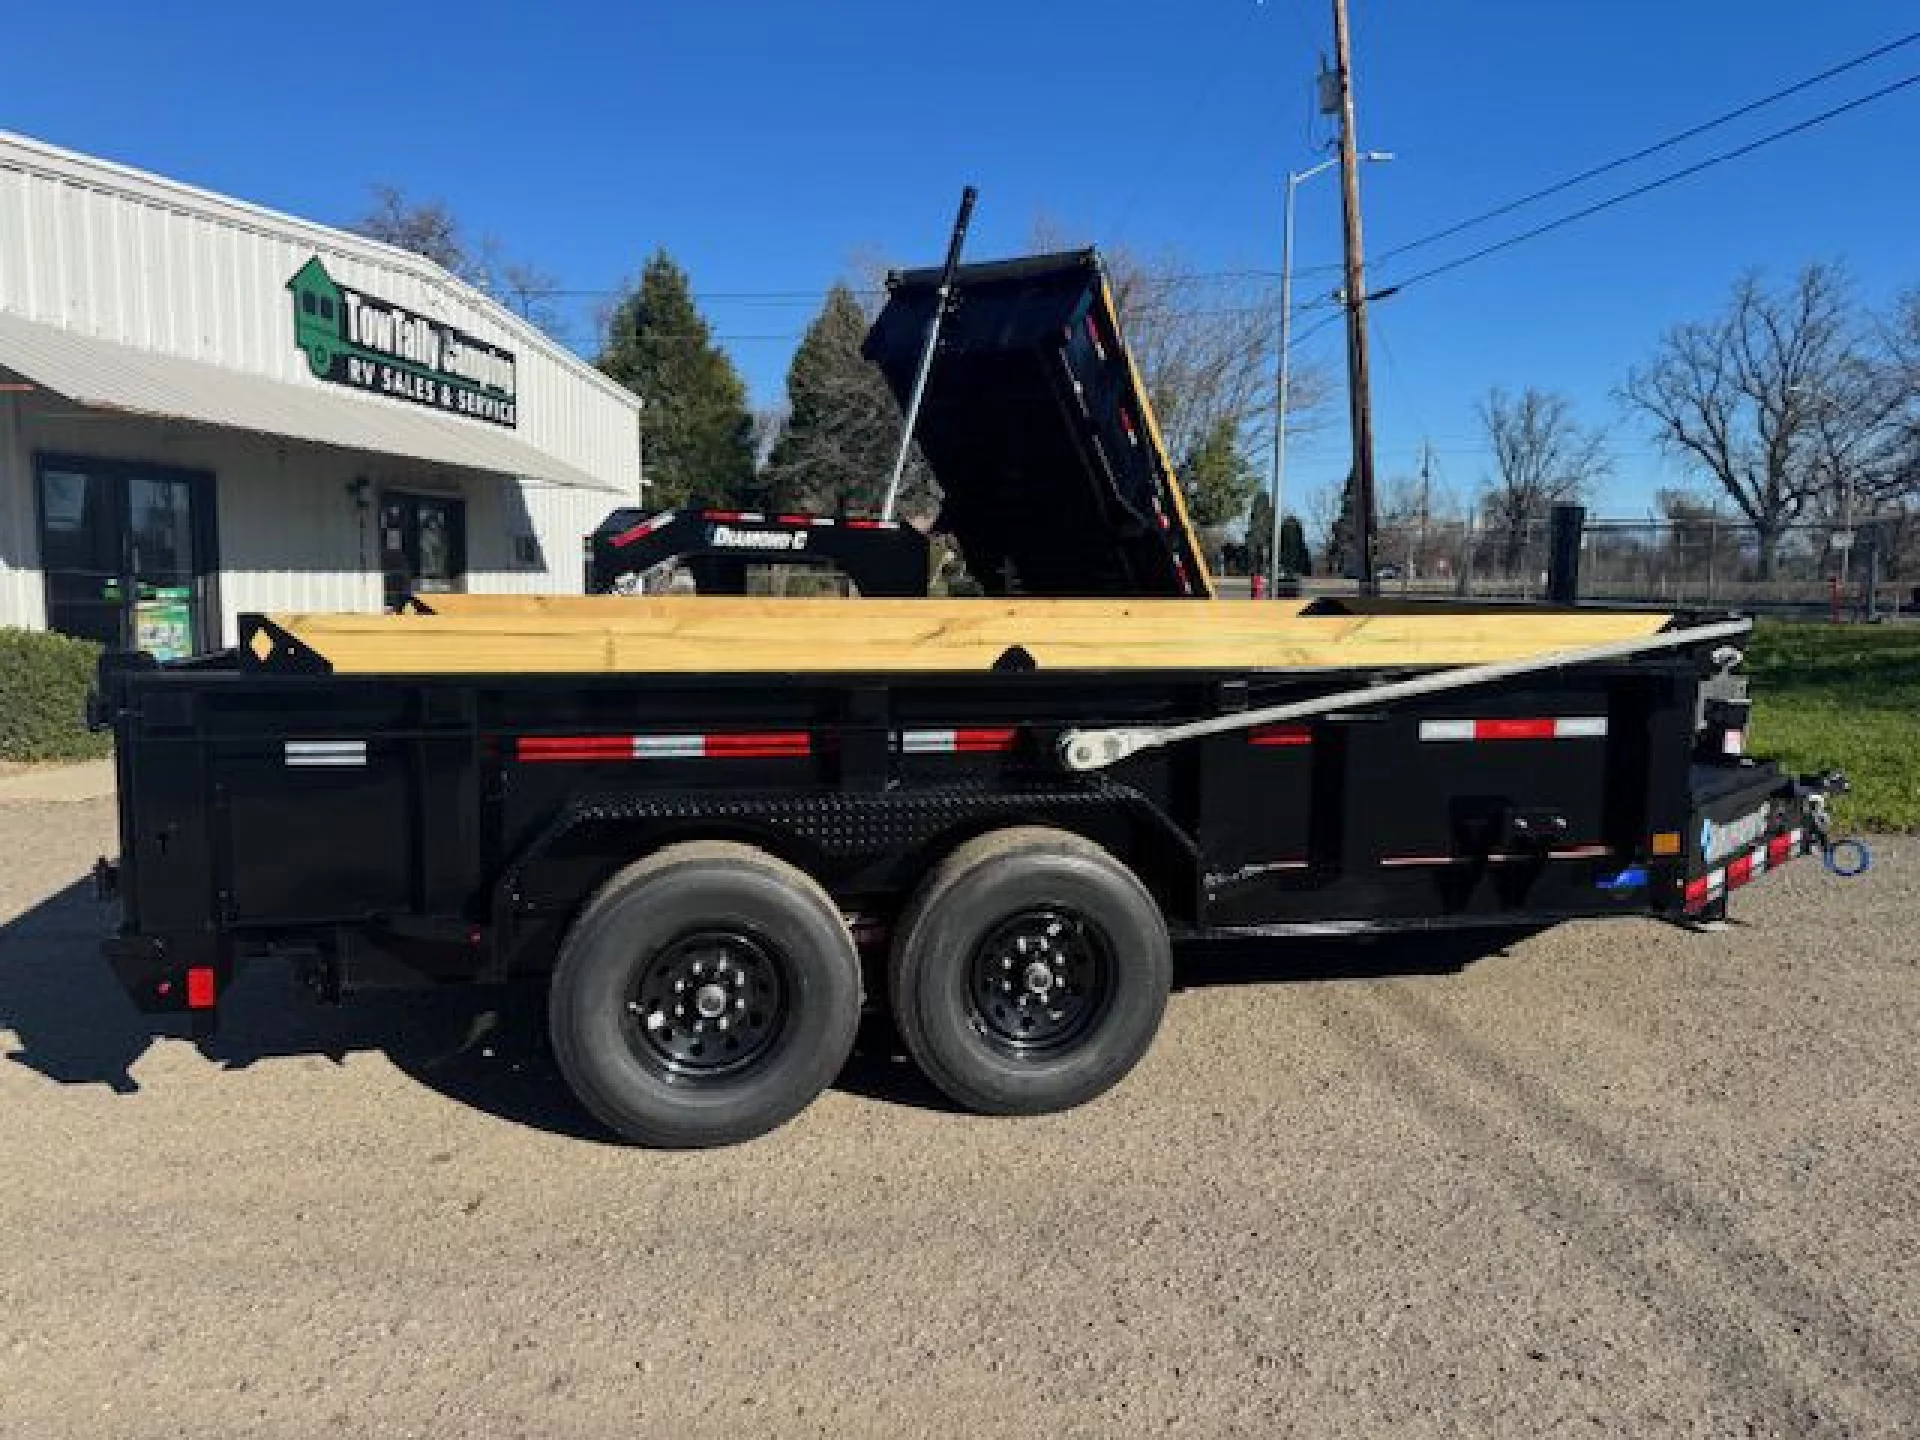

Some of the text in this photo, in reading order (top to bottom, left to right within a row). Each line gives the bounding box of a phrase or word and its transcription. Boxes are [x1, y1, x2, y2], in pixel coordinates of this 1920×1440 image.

[348, 358, 516, 422] RV SALES & SERVICE
